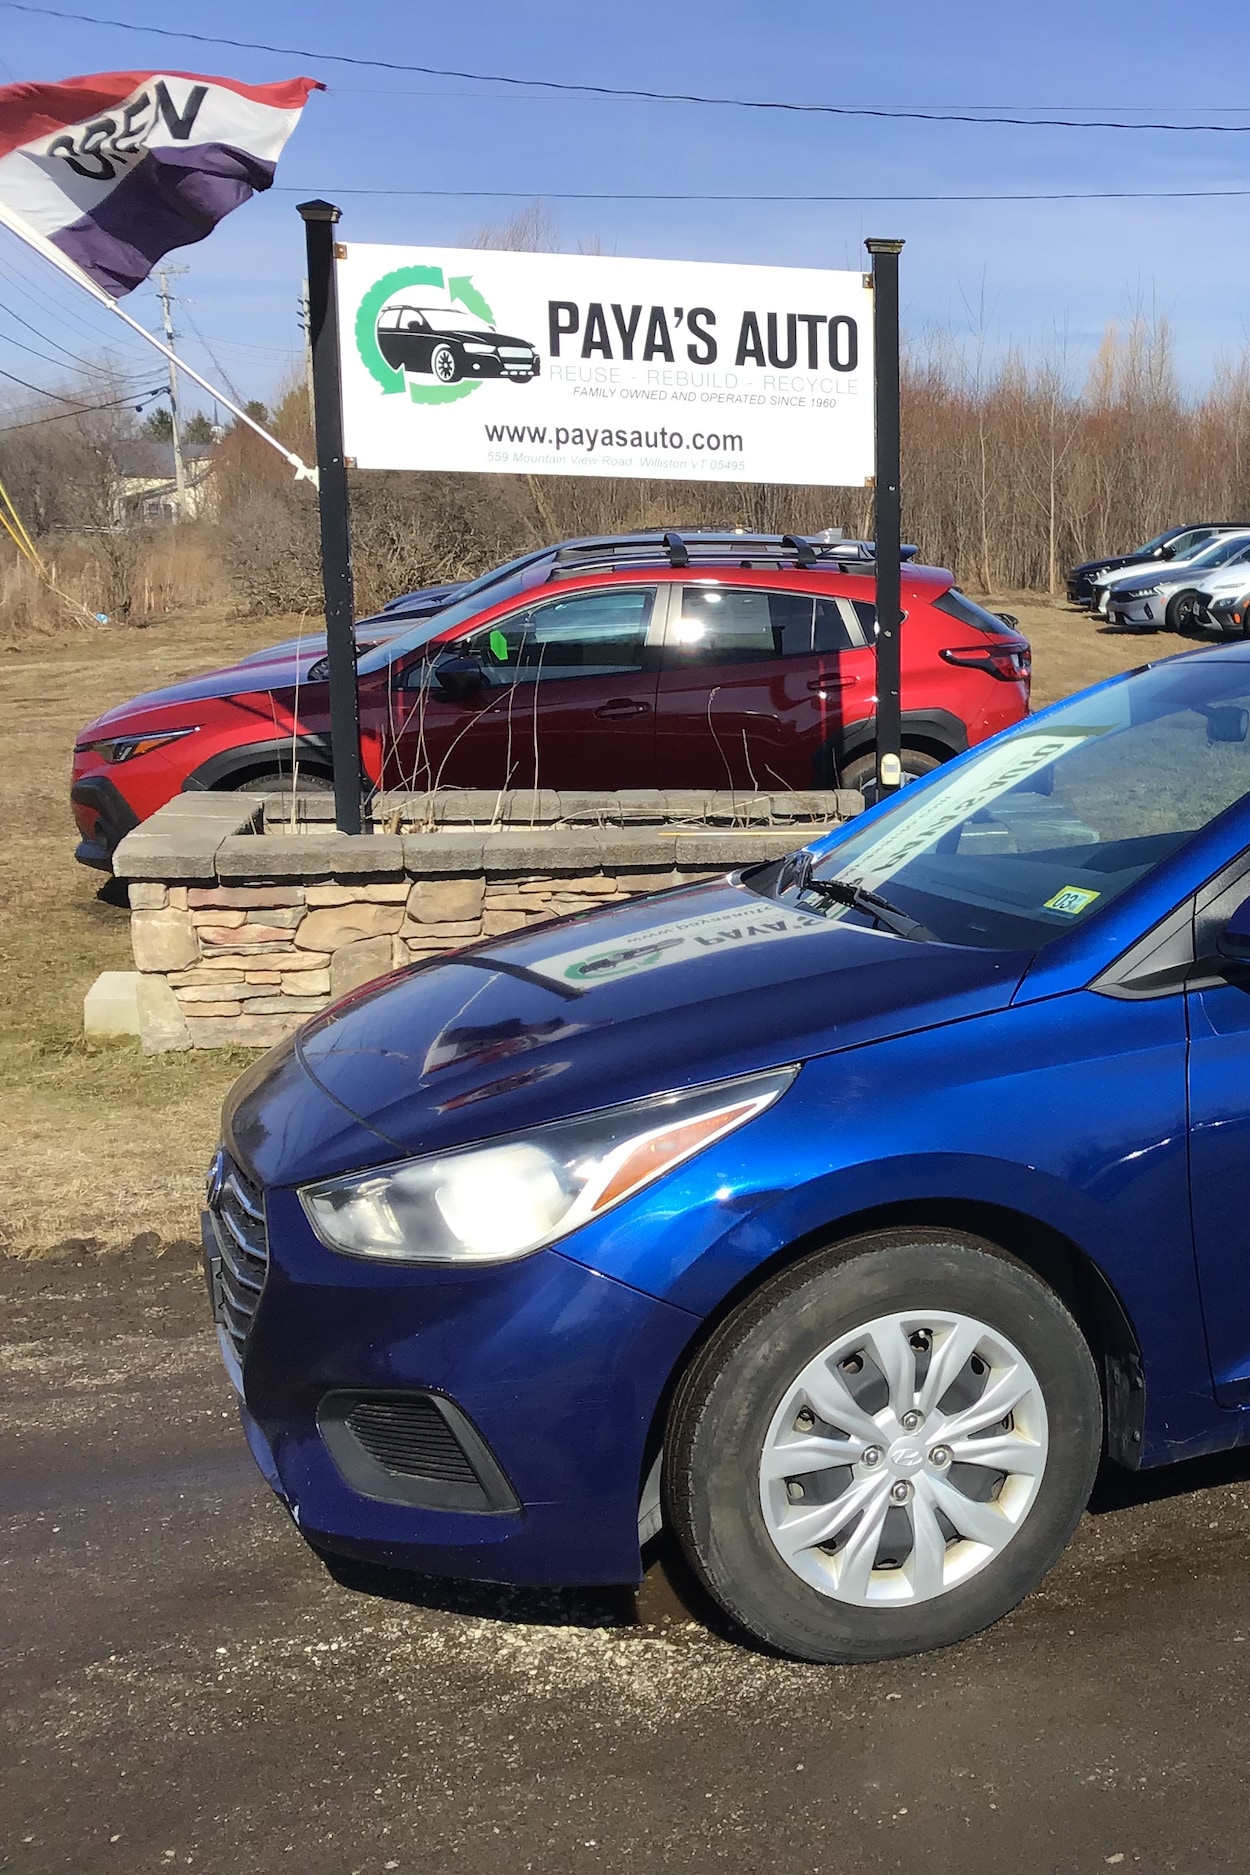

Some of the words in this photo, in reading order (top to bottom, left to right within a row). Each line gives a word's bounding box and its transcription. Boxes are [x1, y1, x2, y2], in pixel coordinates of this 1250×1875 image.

[547, 300, 718, 365] PAYA'S
[735, 311, 858, 372] AUTO
[550, 365, 621, 383] REUSE
[647, 369, 738, 388] REBUILD
[763, 375, 859, 394] RECYCLE
[573, 386, 616, 398] FAMILY
[620, 389, 668, 401] OWNED
[671, 391, 697, 402] AND
[700, 392, 766, 405] OPERATED
[770, 395, 806, 407] SINCE
[811, 398, 836, 408] 1960
[484, 424, 743, 452] www.payasauto.com
[487, 451, 509, 462] 559
[513, 452, 566, 464] Mountain
[571, 455, 598, 465] View
[640, 457, 687, 469] Williston
[691, 460, 707, 469] VT
[710, 460, 745, 471] 05495
[1052, 893, 1079, 909] 03
